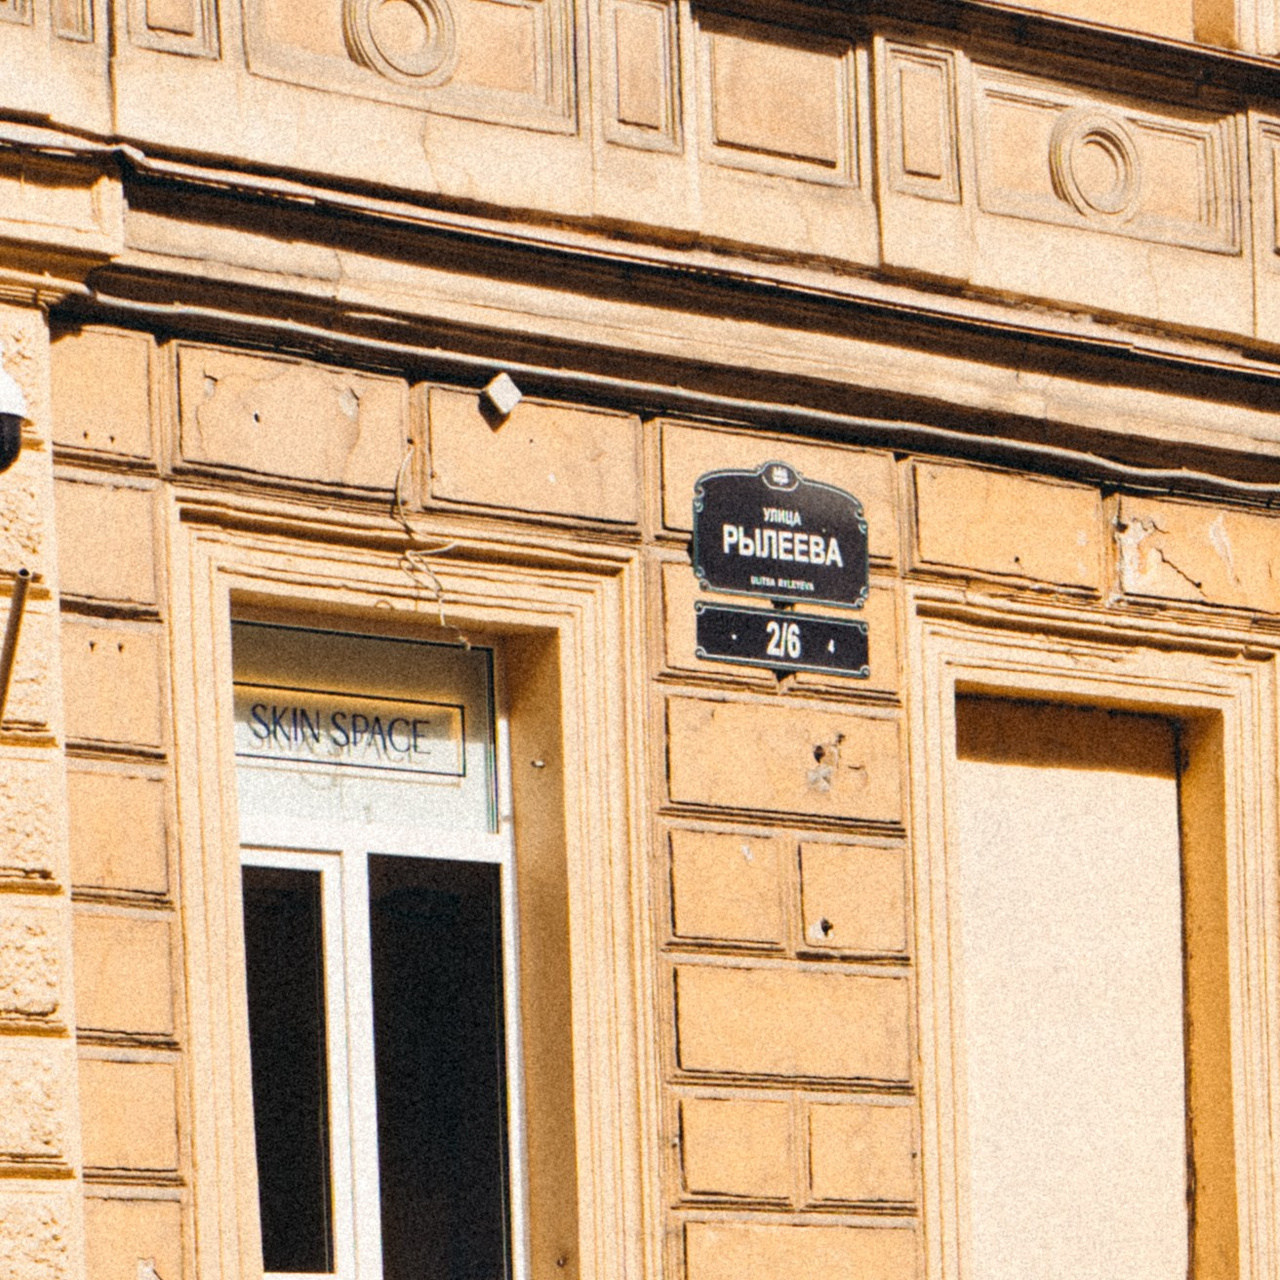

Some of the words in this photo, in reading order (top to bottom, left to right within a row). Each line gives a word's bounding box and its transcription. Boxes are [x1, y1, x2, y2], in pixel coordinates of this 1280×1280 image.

[763, 507, 801, 526] УЛИЦА
[722, 525, 843, 567] РЫЛЕЕВА
[766, 620, 801, 659] 2/6
[251, 703, 320, 744] SKIN
[330, 710, 432, 755] SPACE
